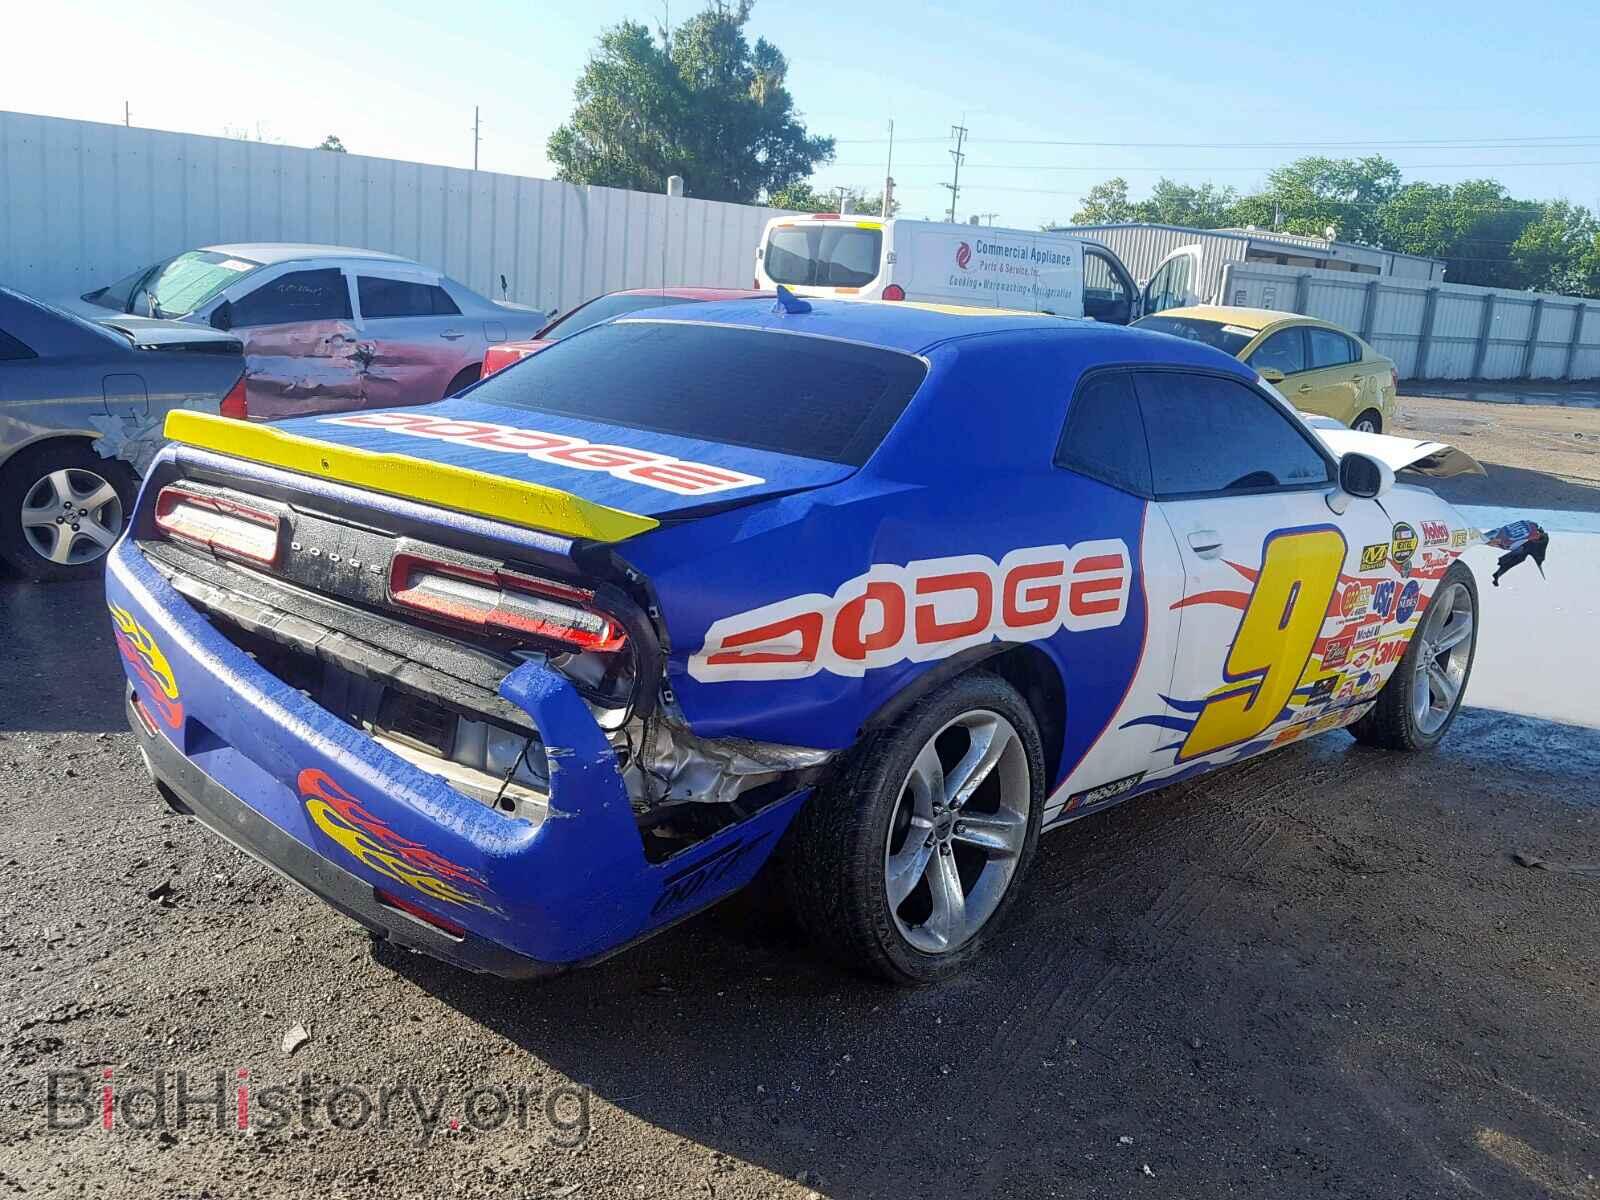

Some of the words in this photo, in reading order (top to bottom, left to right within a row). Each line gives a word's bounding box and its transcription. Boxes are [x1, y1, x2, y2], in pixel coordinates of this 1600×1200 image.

[976, 239, 1029, 260] Commercial
[1030, 247, 1071, 266] Appliance
[979, 260, 997, 272] Parts
[949, 274, 978, 289] Cooking
[340, 413, 741, 491] DODGE
[291, 542, 382, 572] DODGE
[705, 551, 1126, 666] DODGE
[1174, 522, 1349, 764] 9
